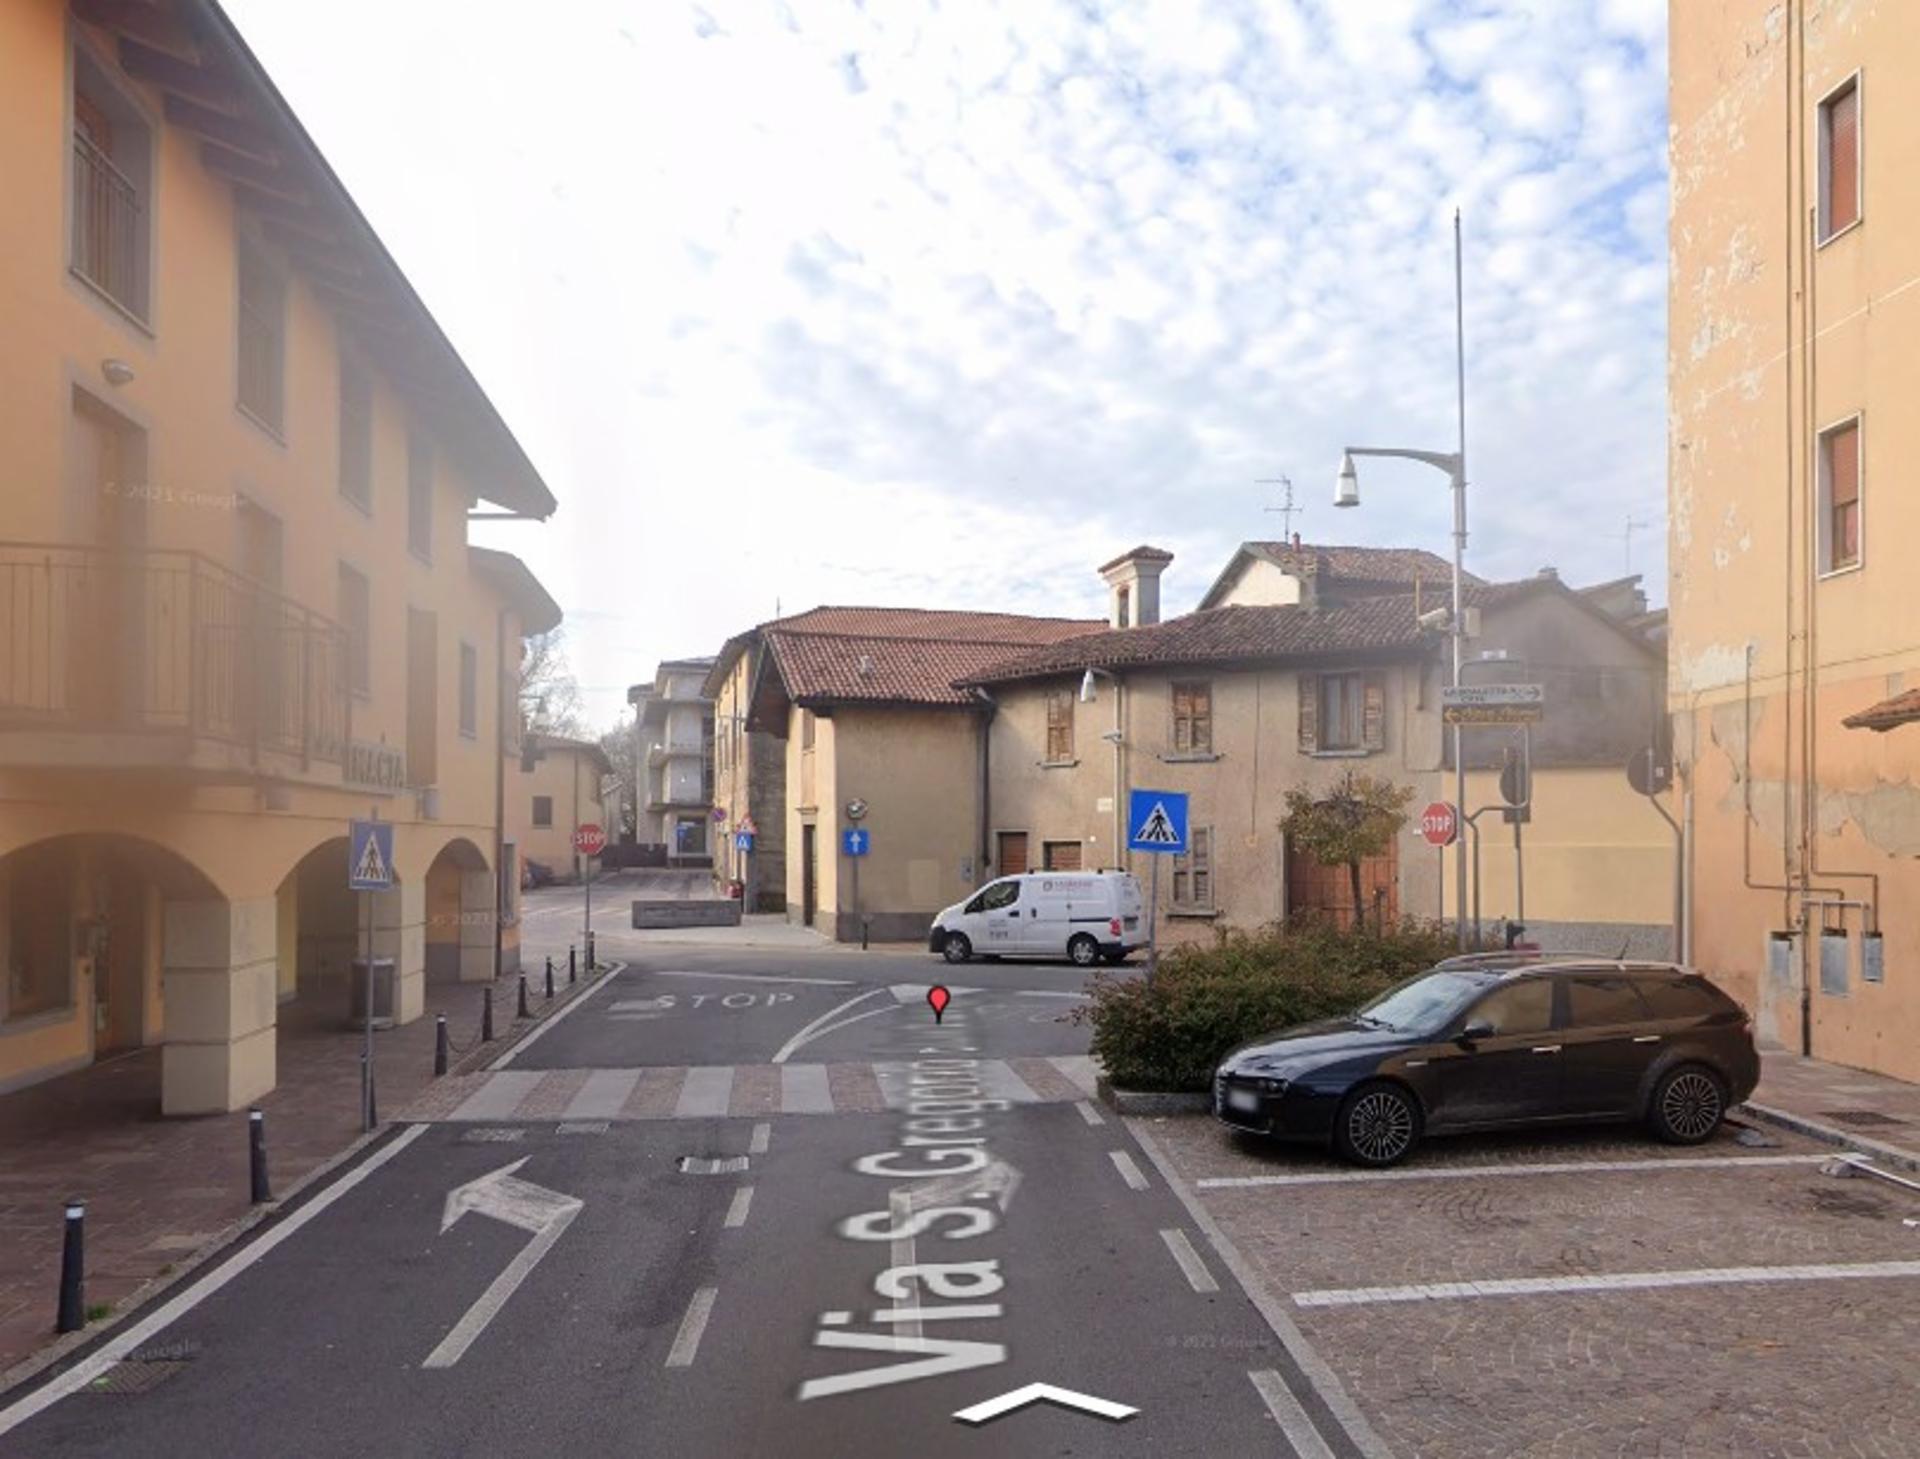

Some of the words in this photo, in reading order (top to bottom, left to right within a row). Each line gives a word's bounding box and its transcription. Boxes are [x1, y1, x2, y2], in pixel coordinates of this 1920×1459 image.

[1423, 816, 1451, 832] STOP
[575, 831, 607, 845] STOP
[656, 993, 795, 1009] STOP
